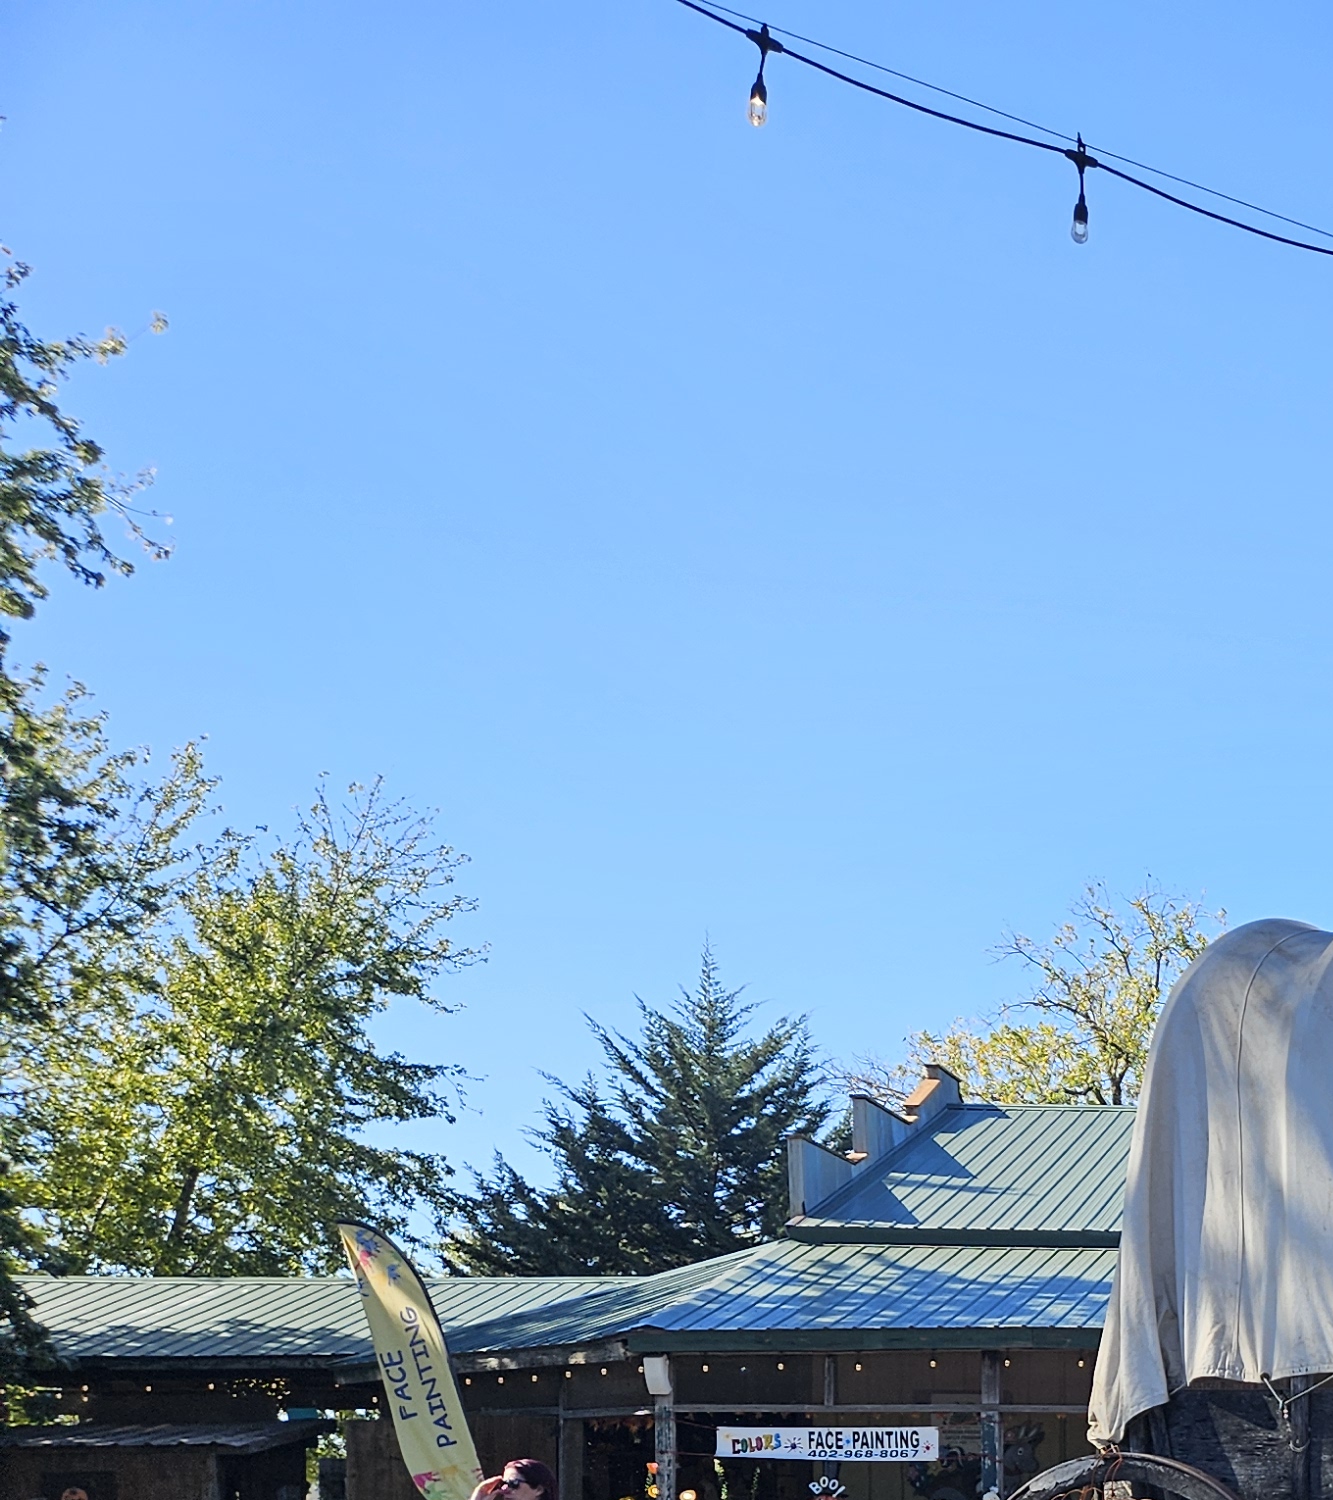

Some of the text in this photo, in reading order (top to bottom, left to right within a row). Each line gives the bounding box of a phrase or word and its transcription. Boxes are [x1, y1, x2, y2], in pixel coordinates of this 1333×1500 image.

[379, 1350, 418, 1421] FACE
[400, 1306, 458, 1448] PAINTING
[731, 1433, 782, 1454] COLORS
[807, 1430, 844, 1450] FACE
[851, 1430, 921, 1450] PAINTING
[807, 1449, 920, 1459] 402-968-8067
[808, 1476, 846, 1498] BOO!
